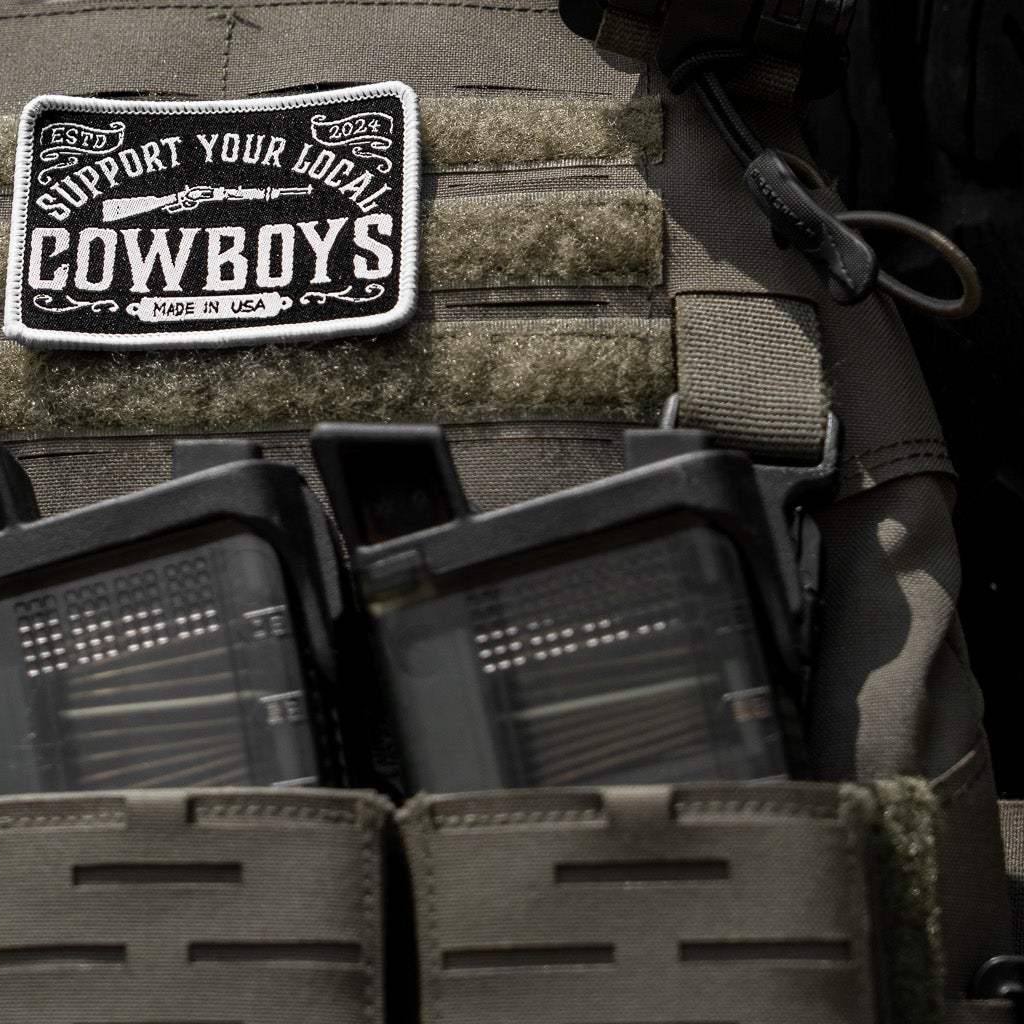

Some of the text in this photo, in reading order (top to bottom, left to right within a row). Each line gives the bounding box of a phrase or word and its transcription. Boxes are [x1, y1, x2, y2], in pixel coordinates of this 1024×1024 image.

[51, 127, 106, 149] ESTD
[329, 118, 380, 140] 2024
[36, 132, 393, 222] SUPPORT YOUR LOCAL
[27, 213, 394, 293] COWBOYS
[153, 297, 266, 317] MADE IN USA
